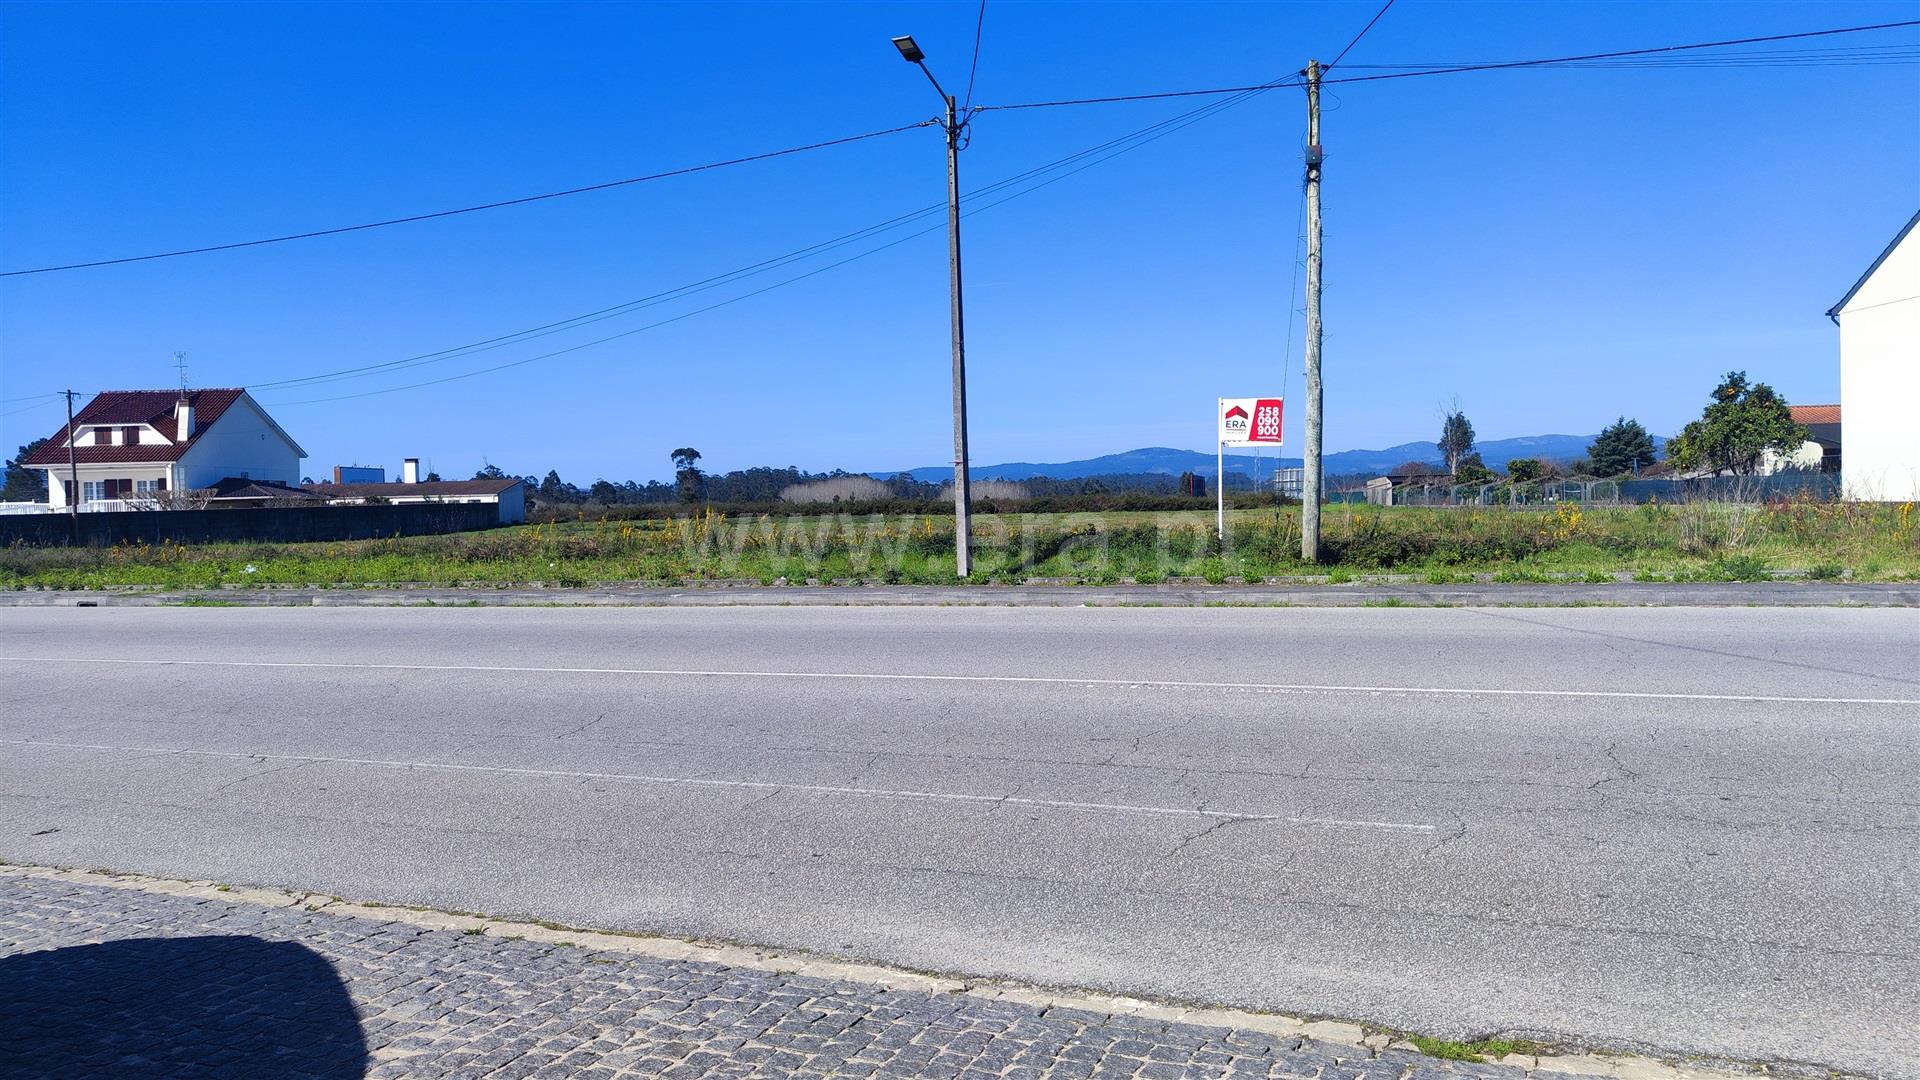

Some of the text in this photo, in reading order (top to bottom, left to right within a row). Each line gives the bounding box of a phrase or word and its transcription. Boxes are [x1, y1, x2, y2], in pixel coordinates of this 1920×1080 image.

[1258, 406, 1279, 416] 258
[1225, 420, 1247, 428] ERA
[1257, 416, 1279, 426] 090
[1257, 425, 1279, 435] 900
